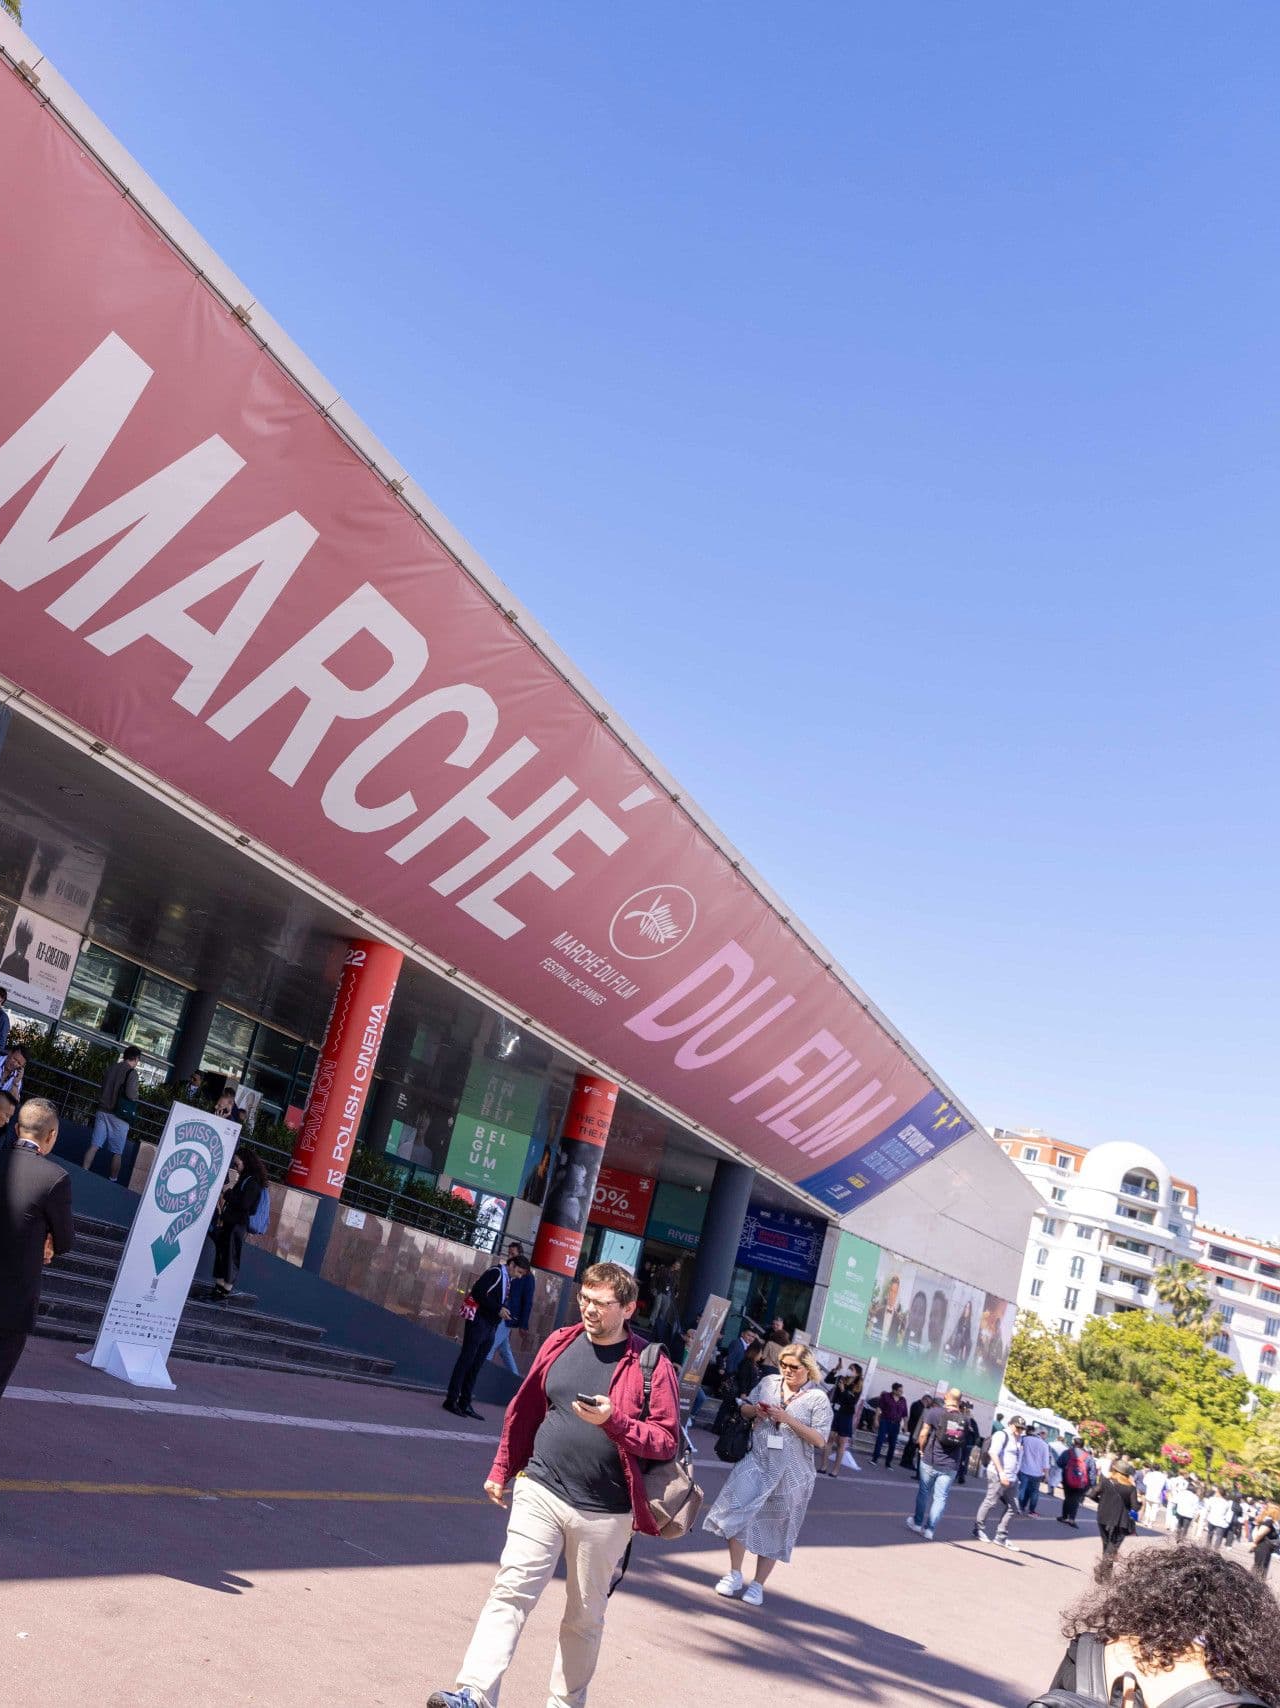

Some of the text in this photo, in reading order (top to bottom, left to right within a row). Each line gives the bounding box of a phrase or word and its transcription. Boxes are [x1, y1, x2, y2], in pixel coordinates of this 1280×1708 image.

[539, 957, 607, 1006] FESTIVAL DE CANNES
[550, 930, 640, 1000] MARCHÉ DU FILM
[623, 939, 796, 1070] DU
[729, 1028, 897, 1160] FILM
[300, 1059, 338, 1152] PAVILION
[332, 1085, 363, 1161] POLISH
[354, 1003, 385, 1082] CINEMA
[576, 1112, 595, 1126] THE
[578, 1125, 598, 1139] THE
[177, 1125, 222, 1176] SWISS QUIZ
[156, 1152, 188, 1212] SWISS QUIZ
[594, 1187, 629, 1210] 0%
